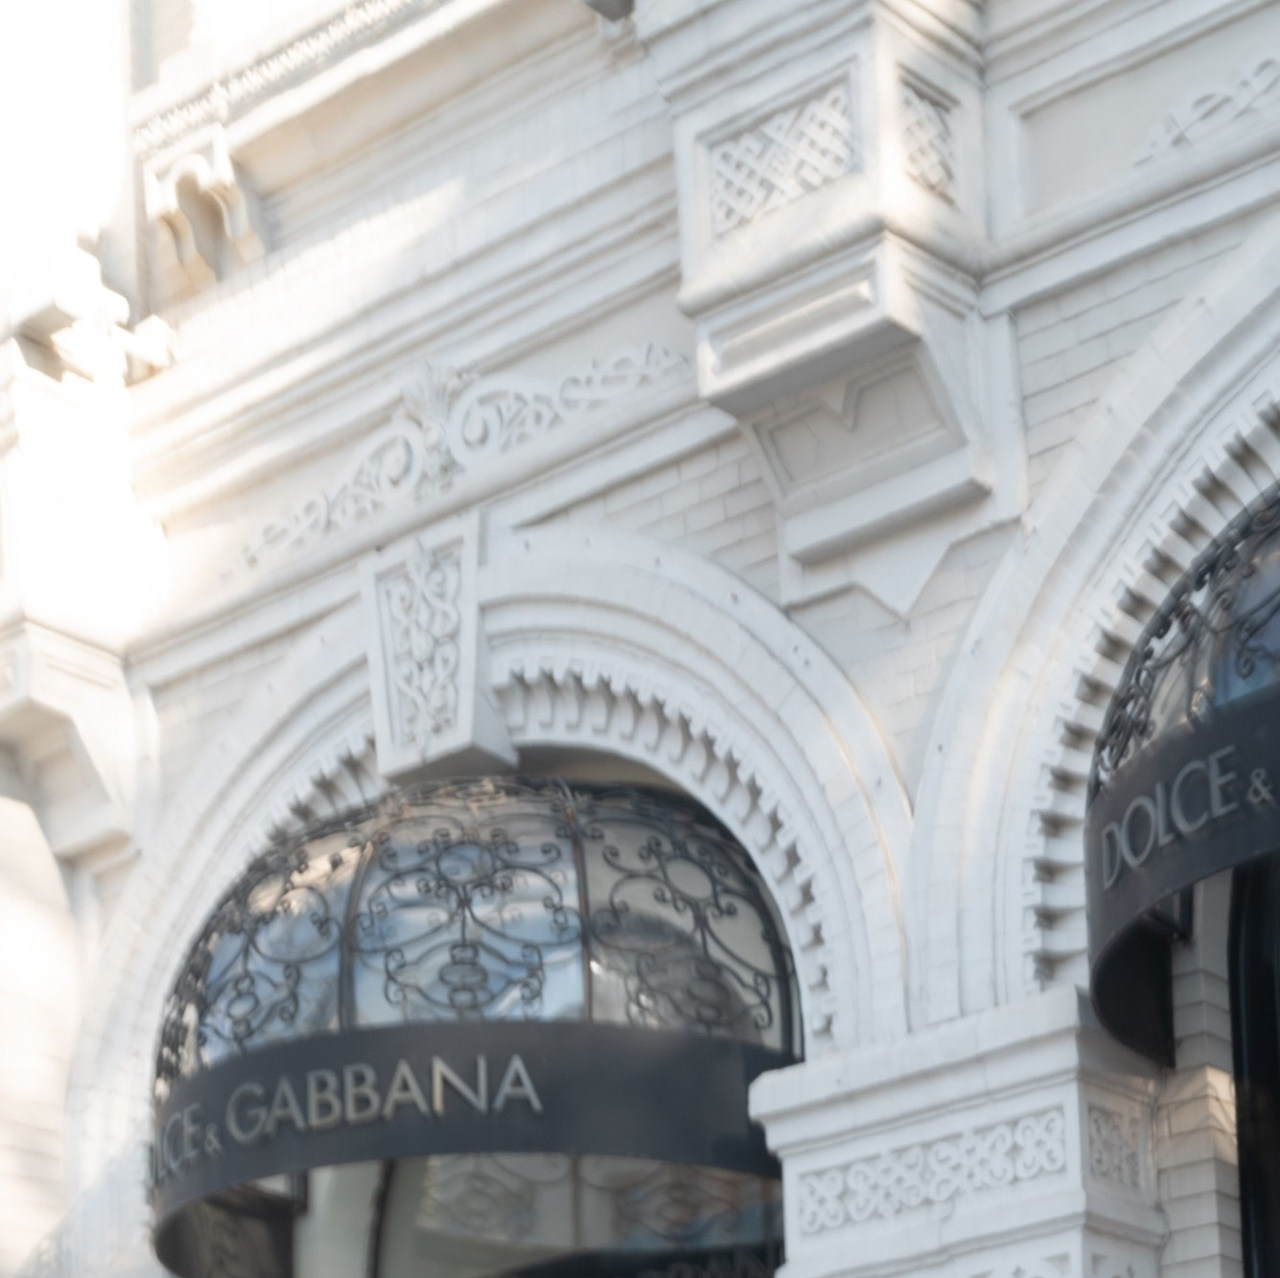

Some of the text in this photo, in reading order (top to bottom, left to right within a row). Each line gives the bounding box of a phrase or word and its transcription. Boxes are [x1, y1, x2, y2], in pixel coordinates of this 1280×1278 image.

[1101, 744, 1240, 890] DOLCE
[1248, 768, 1275, 803] &
[204, 1123, 223, 1154] &
[225, 1054, 543, 1145] GABBANA
